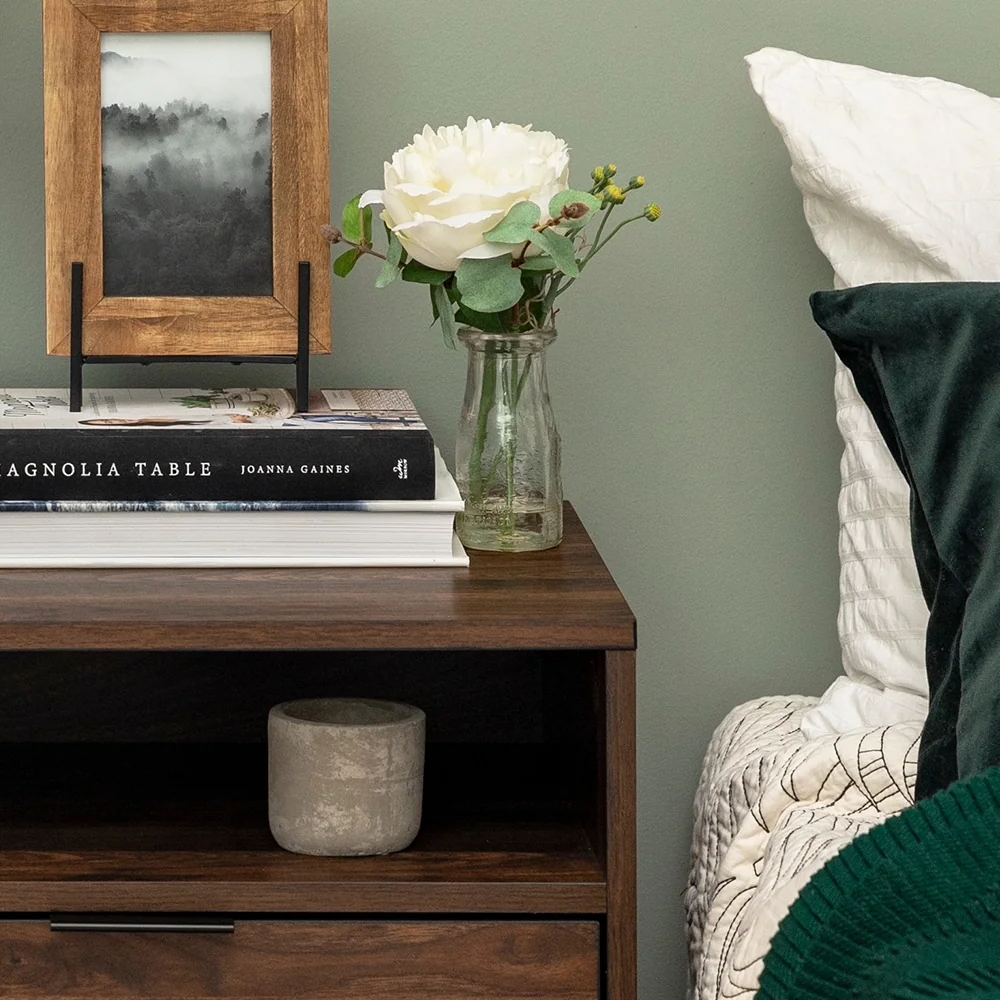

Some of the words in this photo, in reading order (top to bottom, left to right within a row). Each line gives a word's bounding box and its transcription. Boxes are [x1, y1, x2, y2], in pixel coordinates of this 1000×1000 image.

[134, 462, 212, 477] TABLE
[240, 464, 294, 475] JOANNA
[300, 464, 350, 474] GAINES
